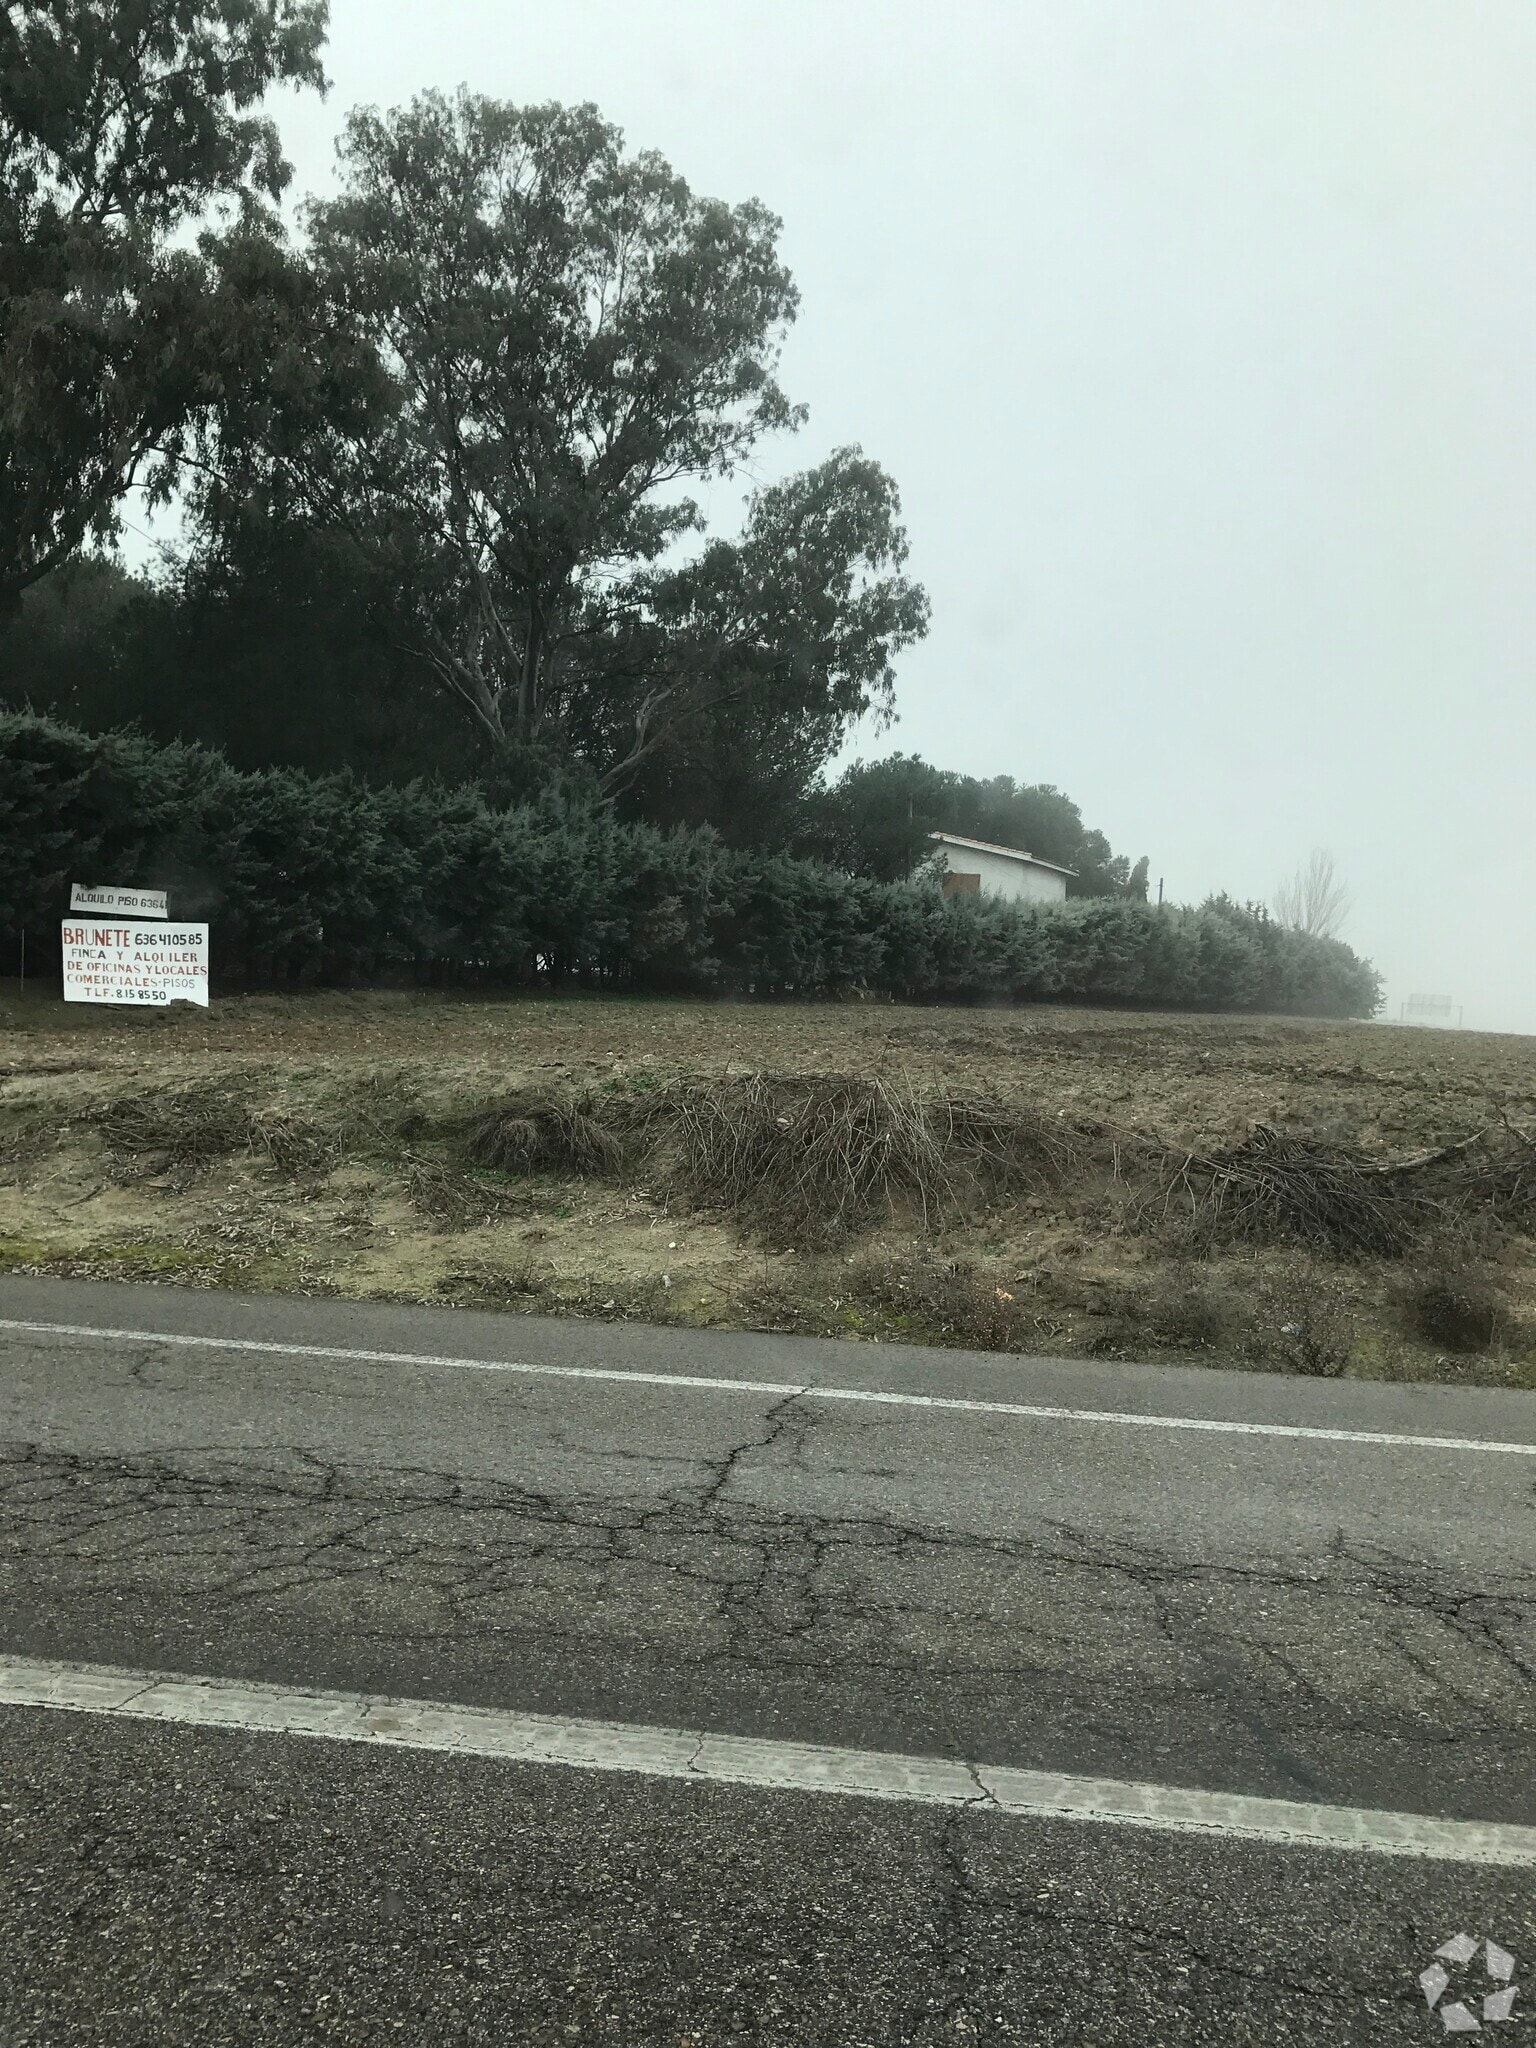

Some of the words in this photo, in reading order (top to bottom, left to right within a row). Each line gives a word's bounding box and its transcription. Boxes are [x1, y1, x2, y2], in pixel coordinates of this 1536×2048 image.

[117, 896, 138, 907] PISO
[63, 927, 131, 948] BRUNETE
[71, 948, 106, 960] FINCA
[116, 951, 124, 961] Y
[134, 952, 198, 963] ALQUILER
[67, 961, 83, 971] DE
[87, 962, 141, 974] OFICINAS
[145, 965, 153, 974] Y
